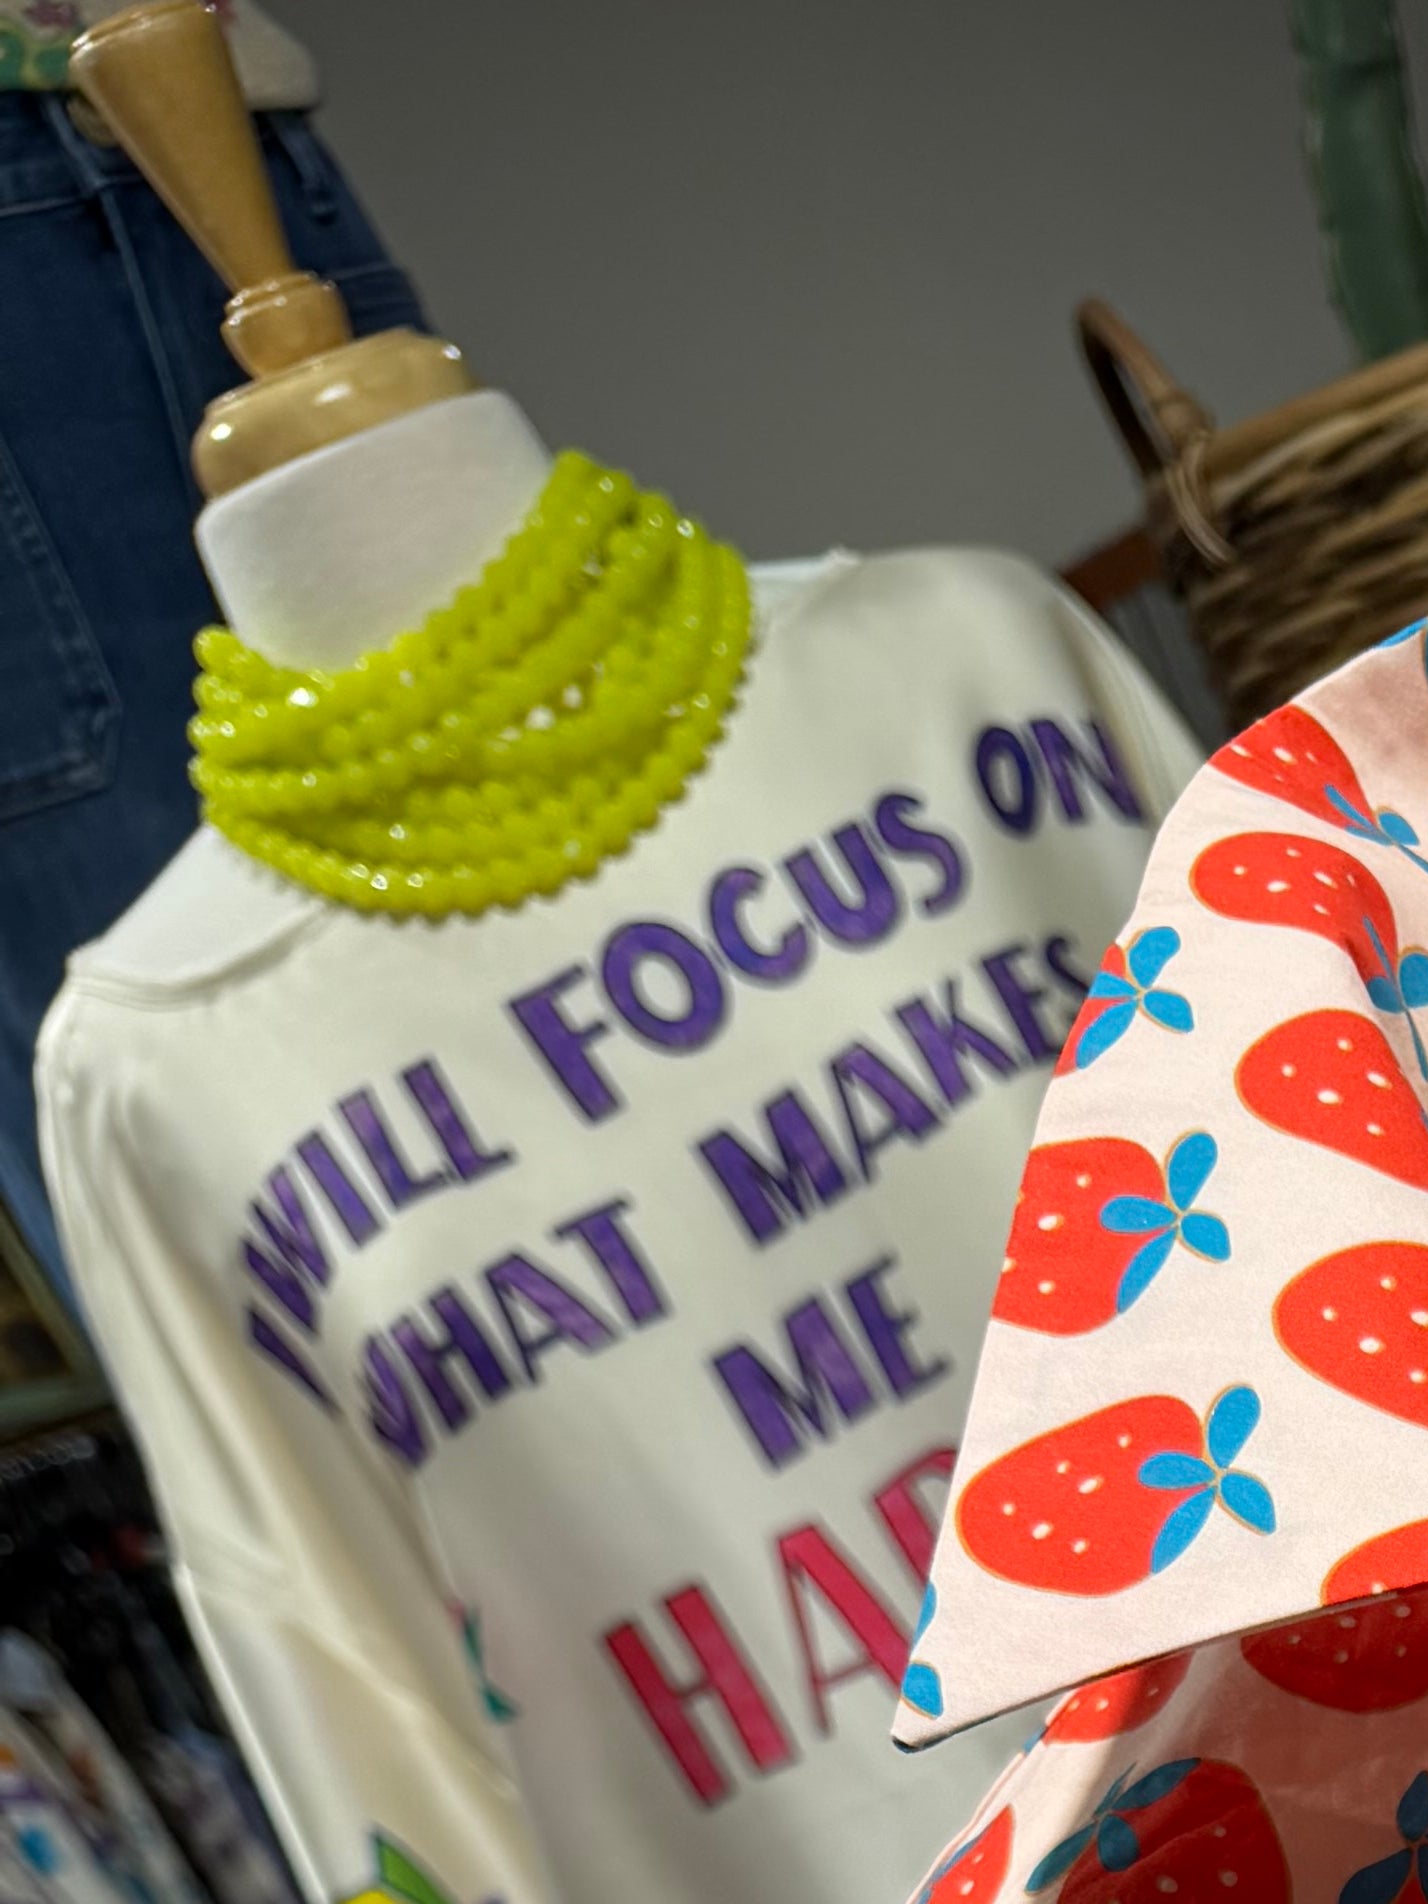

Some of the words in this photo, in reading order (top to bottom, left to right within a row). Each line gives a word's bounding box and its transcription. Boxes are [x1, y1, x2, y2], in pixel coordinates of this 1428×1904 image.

[241, 1056, 515, 1334] WILL
[506, 792, 966, 1126] FOCUS
[976, 718, 1144, 835] ON
[362, 1196, 669, 1468] WHAT
[697, 936, 1091, 1255] MAKES
[711, 1255, 951, 1470] ME
